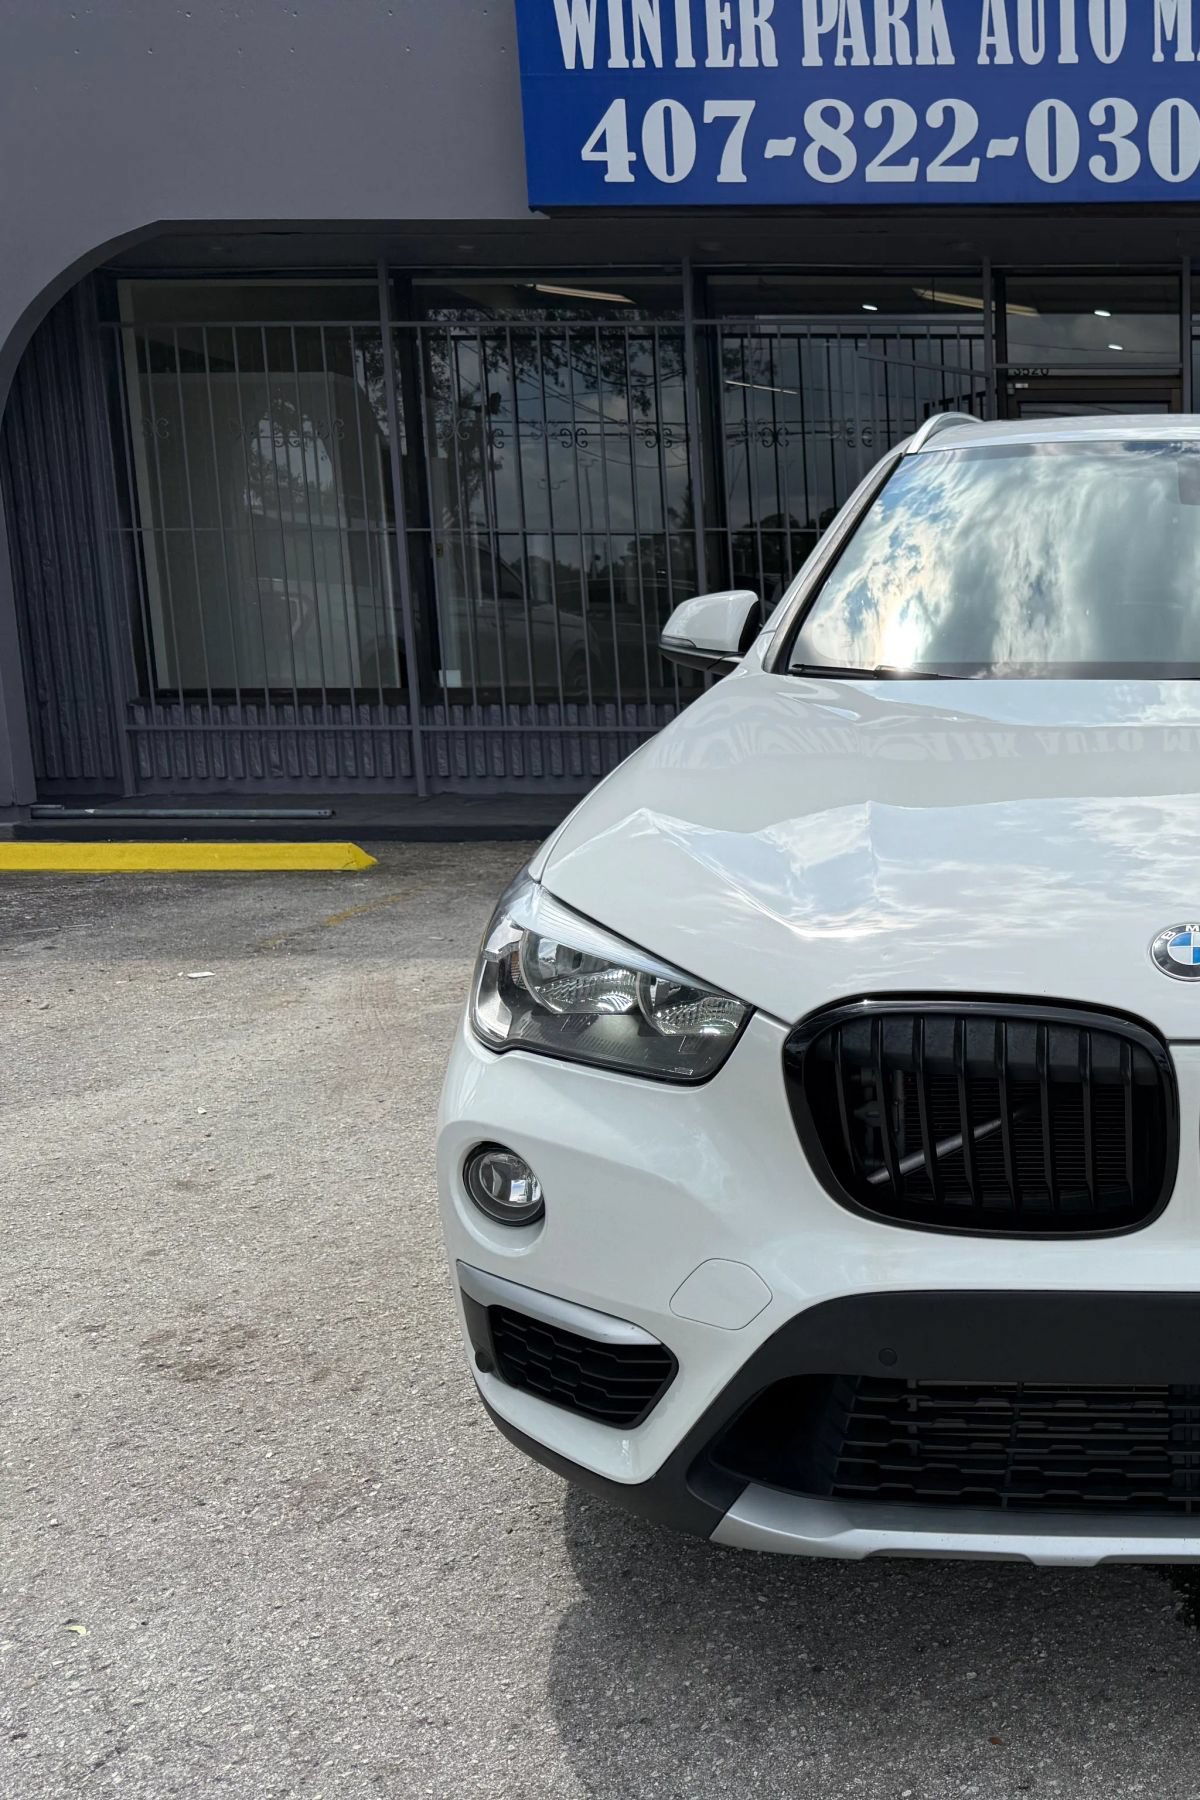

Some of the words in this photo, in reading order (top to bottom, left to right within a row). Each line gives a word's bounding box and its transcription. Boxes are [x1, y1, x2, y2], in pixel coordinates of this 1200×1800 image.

[553, 0, 779, 70] WINTER
[801, 0, 955, 67] PARK
[977, 0, 1127, 65] AUTO
